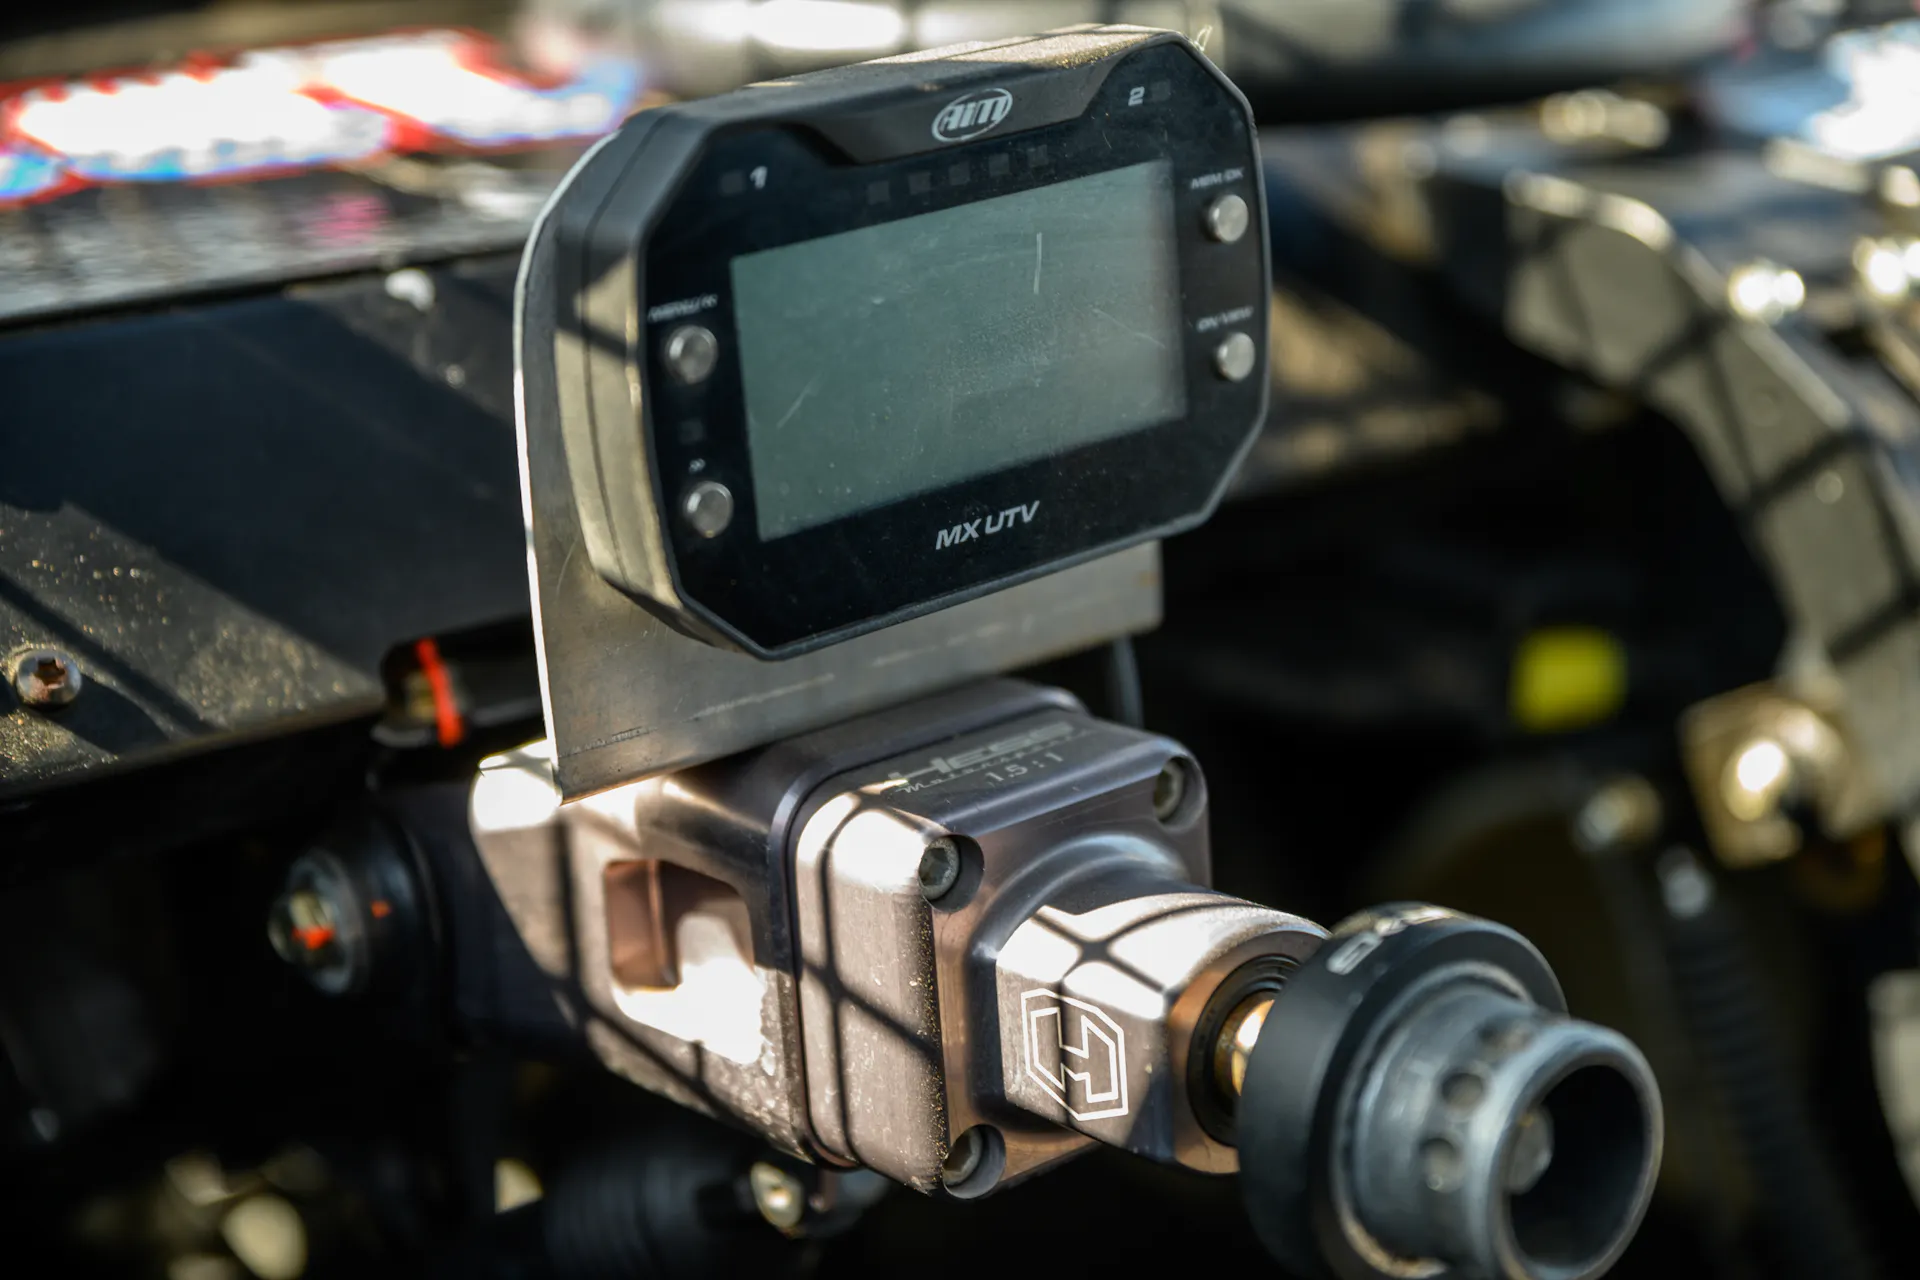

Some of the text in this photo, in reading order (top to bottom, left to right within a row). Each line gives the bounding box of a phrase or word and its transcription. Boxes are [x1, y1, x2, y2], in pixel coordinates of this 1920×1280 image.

[1128, 87, 1145, 106] 2
[749, 165, 768, 190] 1
[936, 500, 1040, 551] MX UTV
